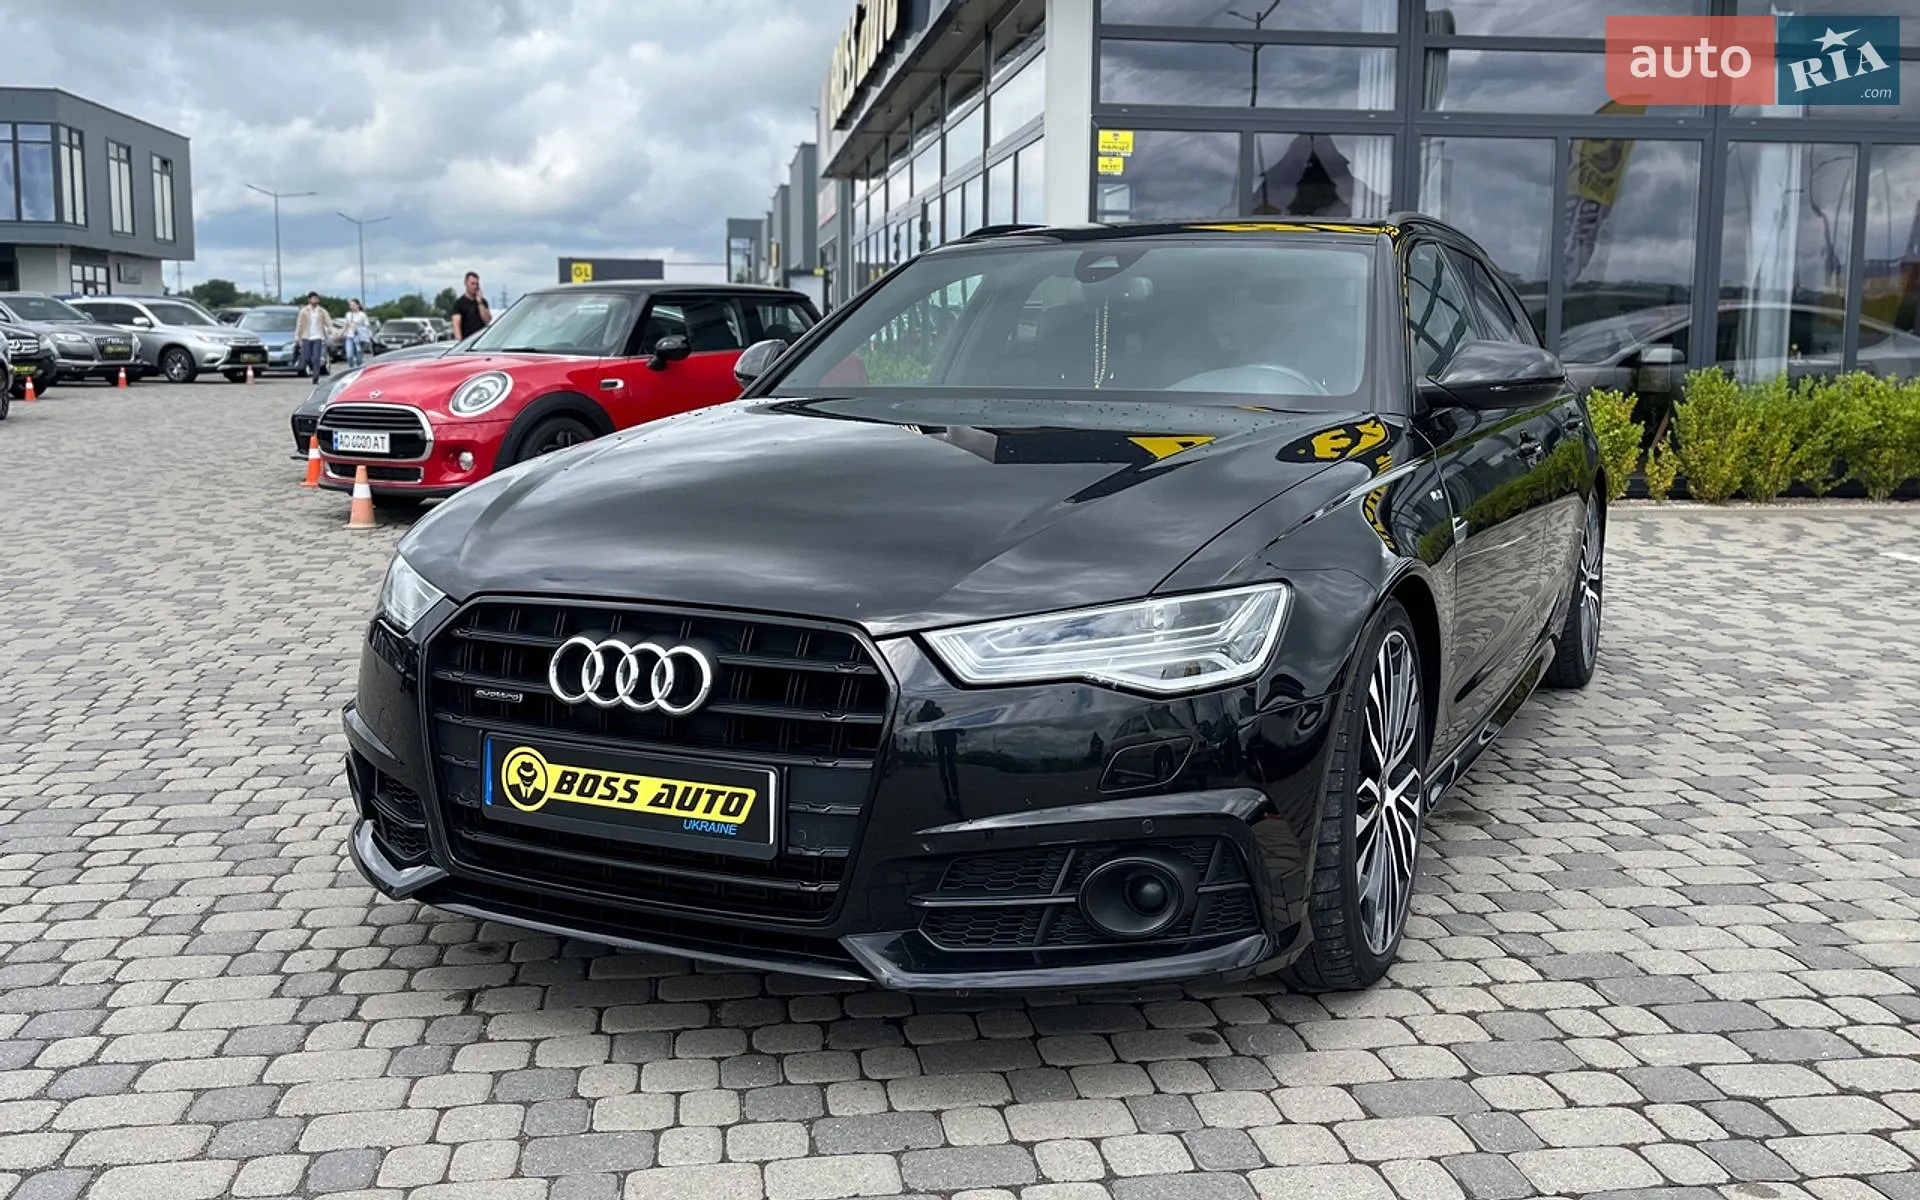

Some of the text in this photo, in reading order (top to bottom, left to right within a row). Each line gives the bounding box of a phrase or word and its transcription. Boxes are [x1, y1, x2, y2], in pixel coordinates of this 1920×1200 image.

[553, 769, 750, 817] BOSS AUTO
[682, 818, 737, 836] UKRAINE
